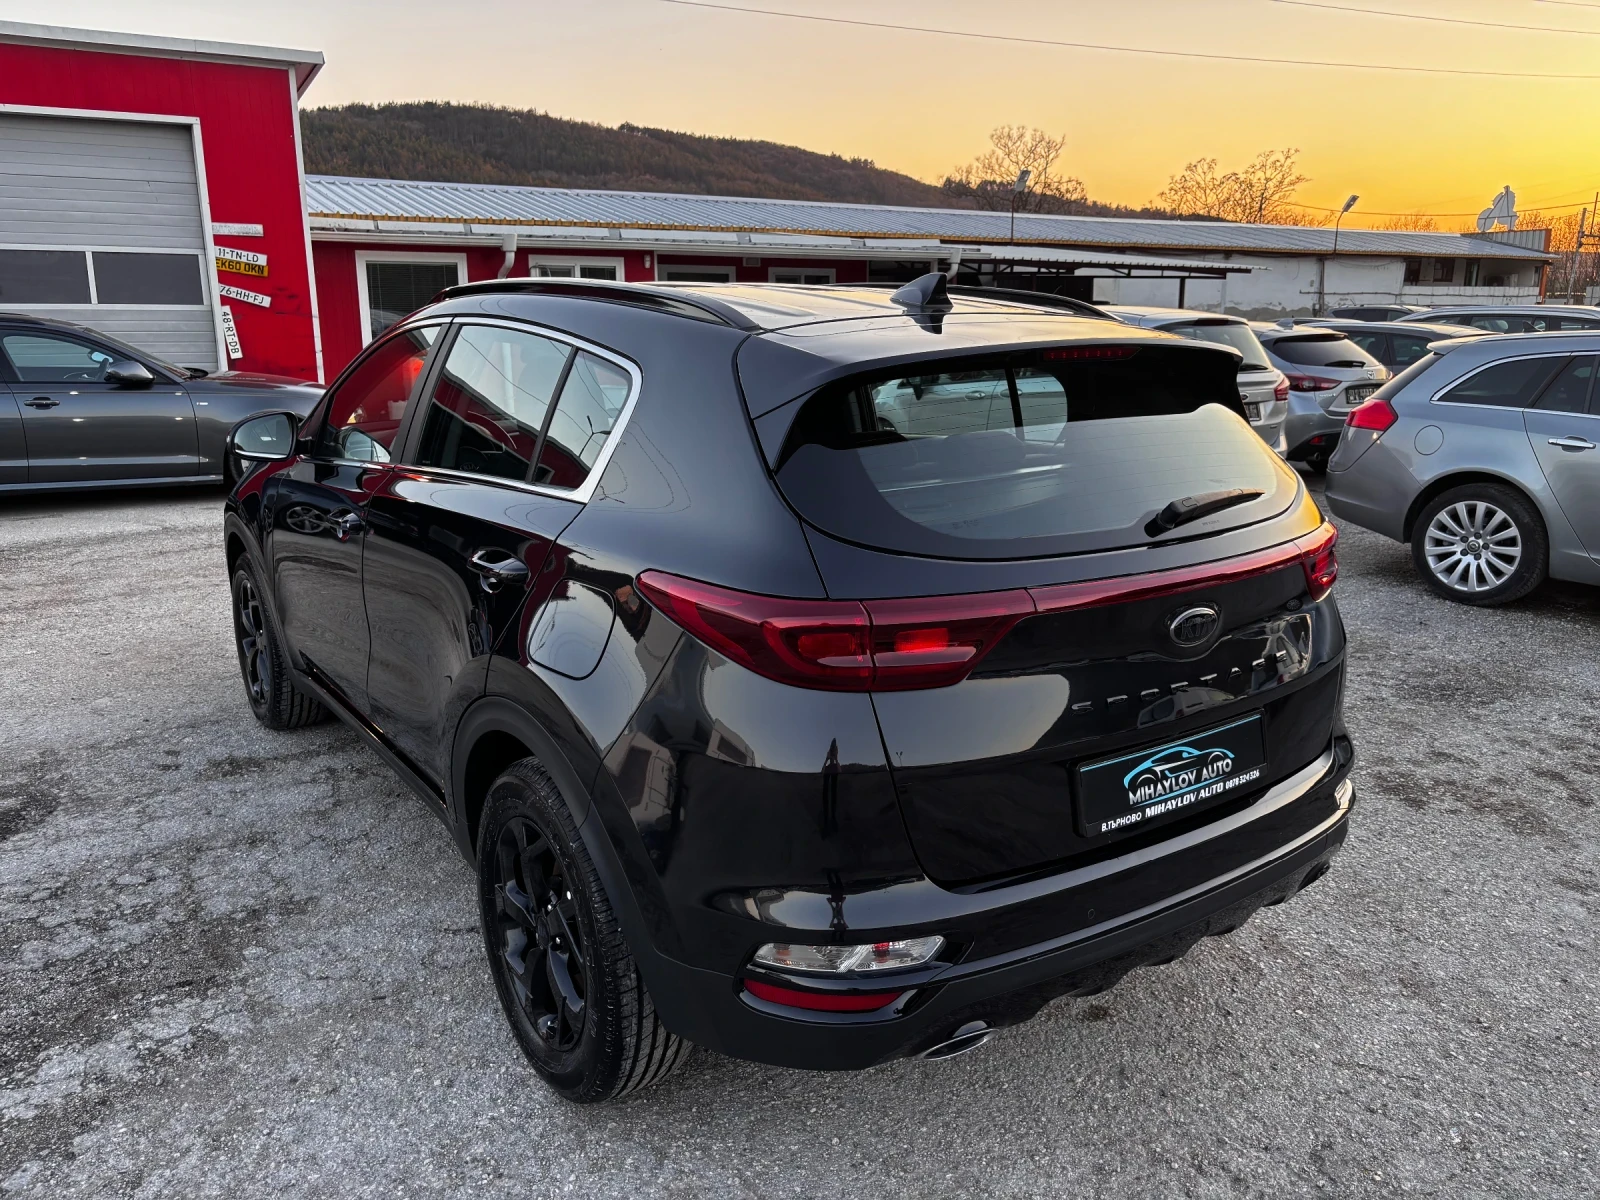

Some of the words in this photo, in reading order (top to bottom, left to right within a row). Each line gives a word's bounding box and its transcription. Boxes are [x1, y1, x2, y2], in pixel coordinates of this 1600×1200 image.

[216, 258, 241, 271] EK60
[218, 248, 259, 263] 11-TN-LD
[220, 285, 265, 305] 76-HH-FJ
[222, 311, 240, 354] 48-RT-DB
[1128, 769, 1197, 805] MIHAYLOV
[1201, 758, 1233, 782] AUTO
[1145, 792, 1197, 818] MIHAYLOV
[1198, 781, 1224, 800] AUTO
